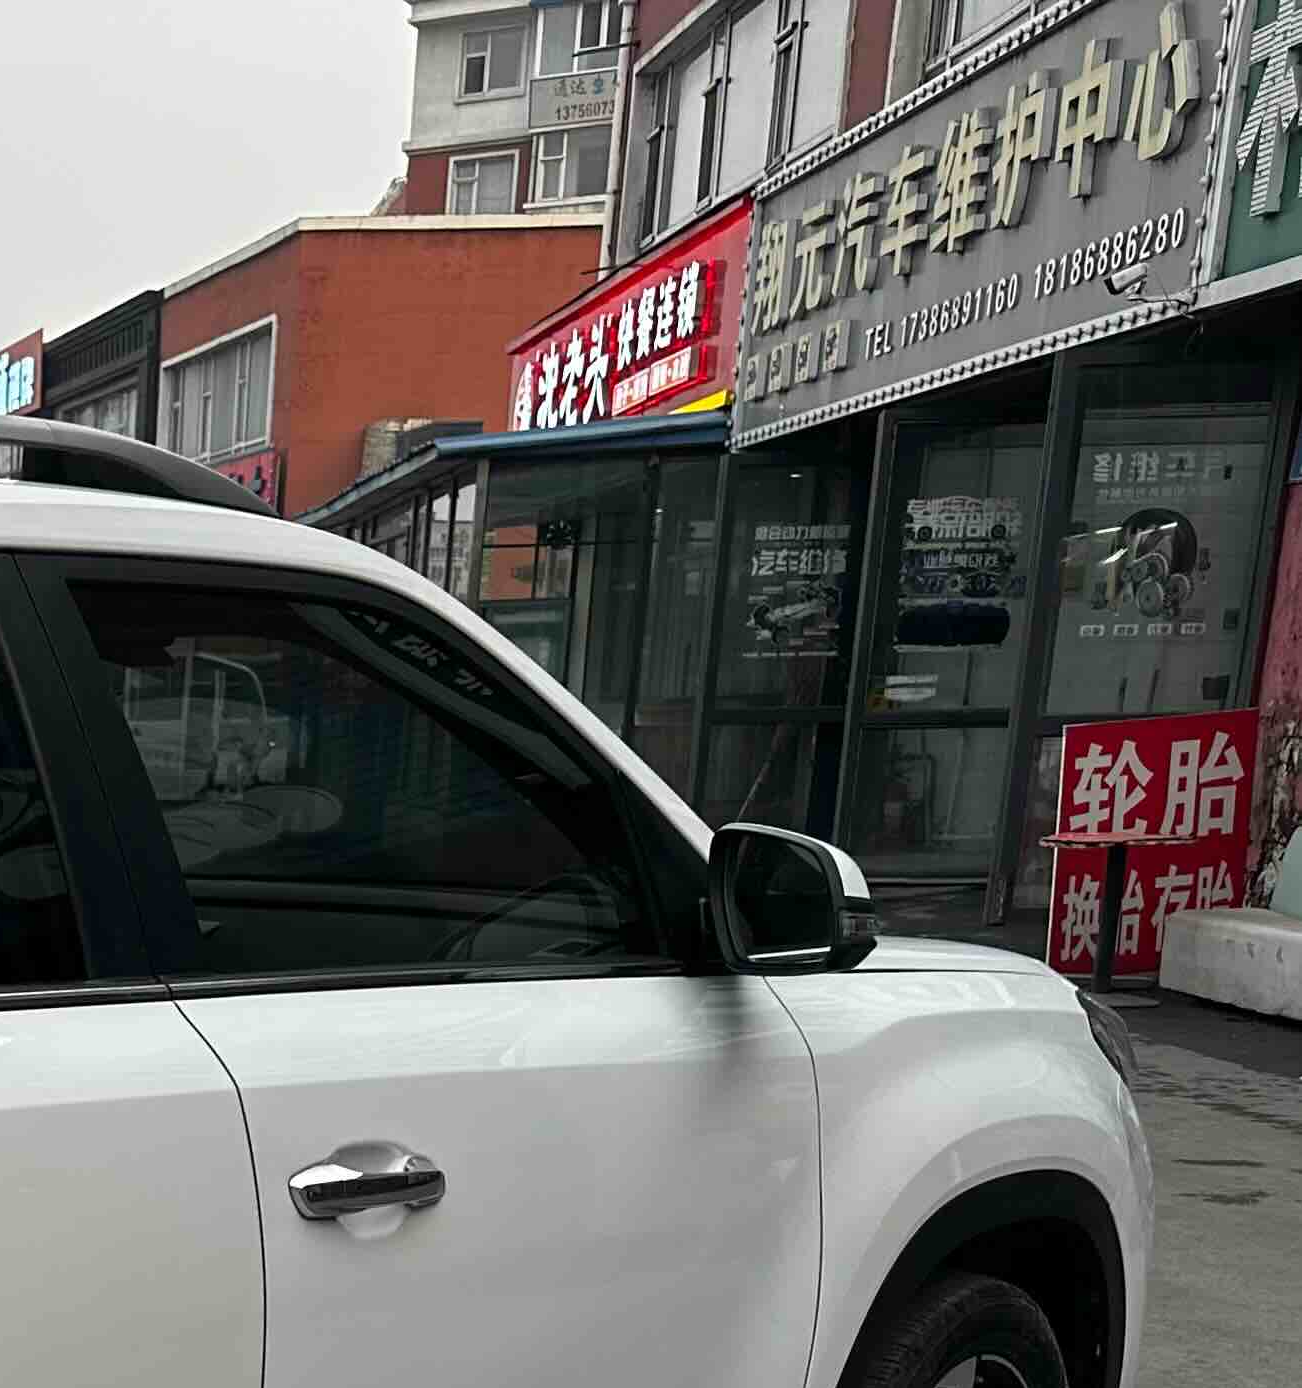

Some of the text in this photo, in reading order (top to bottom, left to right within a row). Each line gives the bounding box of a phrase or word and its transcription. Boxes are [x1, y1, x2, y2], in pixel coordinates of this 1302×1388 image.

[750, 1, 1201, 335] 翔元汽车维护中心
[865, 207, 1186, 360] TEL 17386891160 18186886280
[1069, 730, 1245, 837] 轮胎
